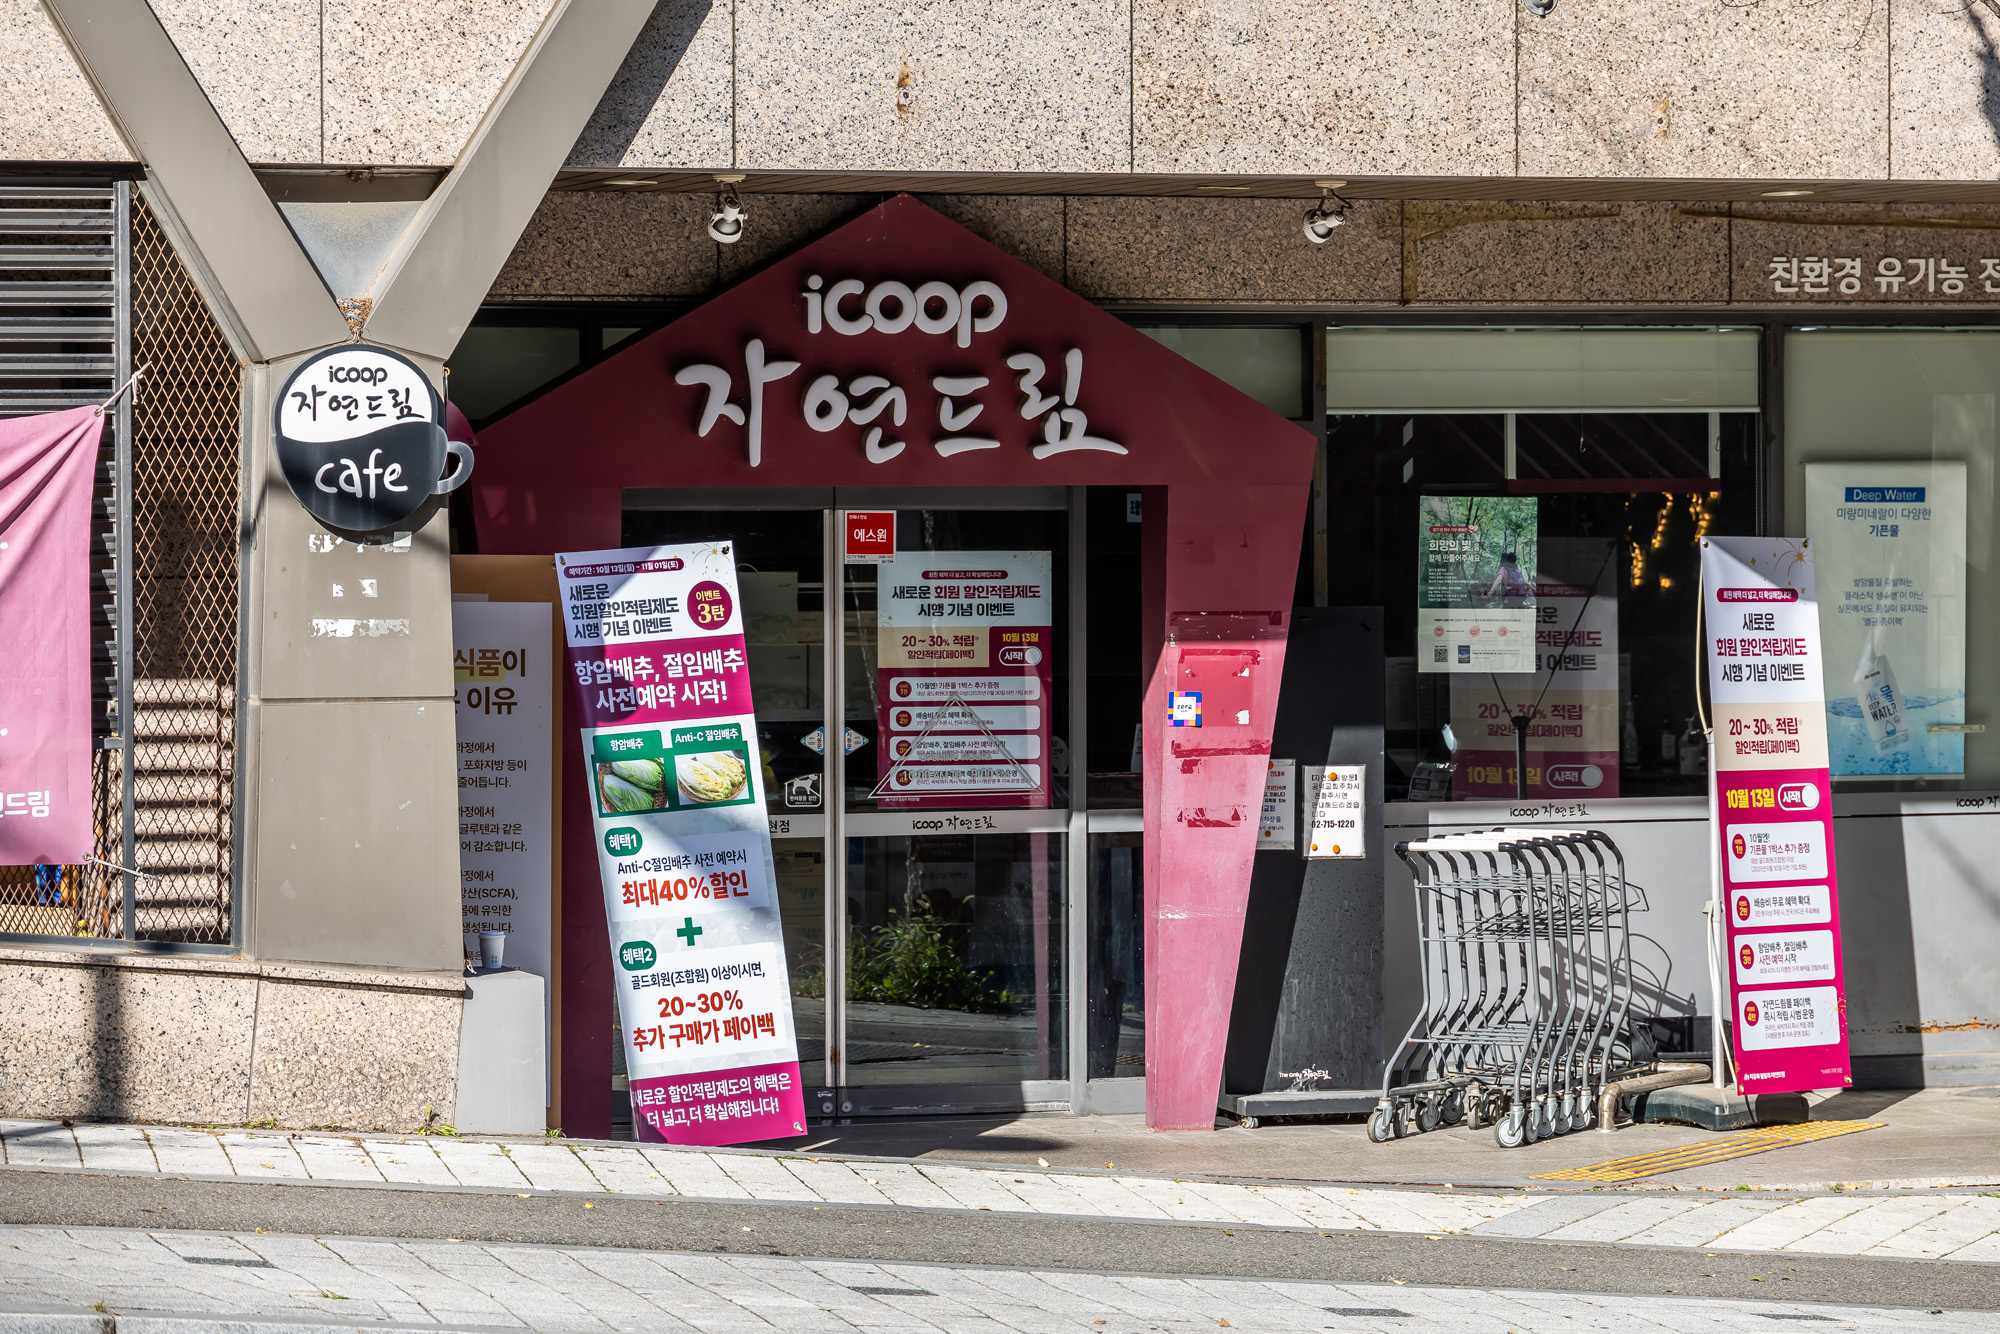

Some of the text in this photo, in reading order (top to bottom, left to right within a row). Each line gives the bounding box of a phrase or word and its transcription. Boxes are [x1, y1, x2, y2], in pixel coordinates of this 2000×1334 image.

[1768, 256, 1862, 294] 친환경
[1874, 257, 1969, 294] 유기농
[801, 274, 1008, 349] icoop
[329, 365, 388, 387] icoop
[291, 384, 425, 422] 자연드림
[674, 337, 1130, 469] 자연드림
[315, 448, 409, 499] cafe
[1853, 489, 1917, 503] Deep Water
[1836, 508, 1931, 521] 미량미네랄이 다양한
[853, 528, 887, 543] 에스원
[1869, 525, 1899, 537] 기픈물
[1429, 540, 1459, 551] 희망의
[1429, 554, 1480, 562] 함께 만들어주세요
[569, 583, 610, 601] 새로운
[695, 590, 722, 602] 이벤트
[892, 585, 1041, 599] 새로운 회원 할인적립제도
[570, 597, 680, 620] 회원할인적립제도
[697, 604, 725, 624] 3탄
[918, 602, 1015, 616] 시행 기념 이벤트
[574, 617, 673, 639] 시행 기념 이벤트
[1743, 613, 1775, 631] 새로운
[1002, 633, 1039, 642] 10월 13일
[907, 650, 975, 659] 할인적립(페이백)
[1716, 638, 1807, 656] 회원 할인적립제도
[454, 648, 525, 677] 식품이
[1004, 651, 1023, 660] 시작!
[1547, 654, 1597, 671] 이벤트
[574, 648, 744, 685] 항암배추, 절임배추
[1722, 664, 1805, 682] 시행 기념 이벤트
[467, 686, 518, 715] 이유
[596, 679, 728, 713] 사전예약 시작!
[1870, 702, 1898, 722] WATER
[675, 728, 739, 743] Anti-C 절임배추
[610, 738, 644, 751] 항암배추
[1735, 739, 1800, 755] 할인적립(페이백)
[464, 758, 527, 772] 포화지방 등이
[1466, 766, 1502, 784] 10월
[1553, 770, 1578, 782] 시작!
[0, 790, 50, 818] 드림
[1726, 788, 1775, 808] 10월 13일
[1956, 798, 1985, 809] icoop
[1510, 803, 1590, 818] icoop 자연드림
[502, 823, 523, 836] 같은
[912, 815, 997, 831] icoop 자연드림
[1311, 820, 1355, 829] 02-715-1220
[474, 840, 528, 853] 감소합니다.
[609, 833, 638, 851] 혜택1
[1784, 843, 1797, 854] 추가
[694, 852, 714, 867] 사전
[716, 849, 747, 866] 예약시
[461, 870, 494, 882] 정에서
[481, 904, 512, 917] 유익한
[1772, 897, 1784, 908] 무료
[1784, 940, 1808, 952] 절임배추
[622, 948, 654, 965] 혜택2
[1759, 954, 1770, 965] 사전
[1785, 953, 1797, 963] 시작
[631, 961, 766, 990] 골드회원(조합원) 이상이시면,
[657, 990, 744, 1018] 20~30%
[1763, 1009, 1815, 1022] 즉시 적립 시범 운영
[633, 1012, 776, 1052] 추가 구매가 페이백
[668, 1077, 752, 1101] 할인적립제도의
[753, 1072, 792, 1093] 혜택은
[646, 1096, 779, 1128] 더 확실해집니다!
